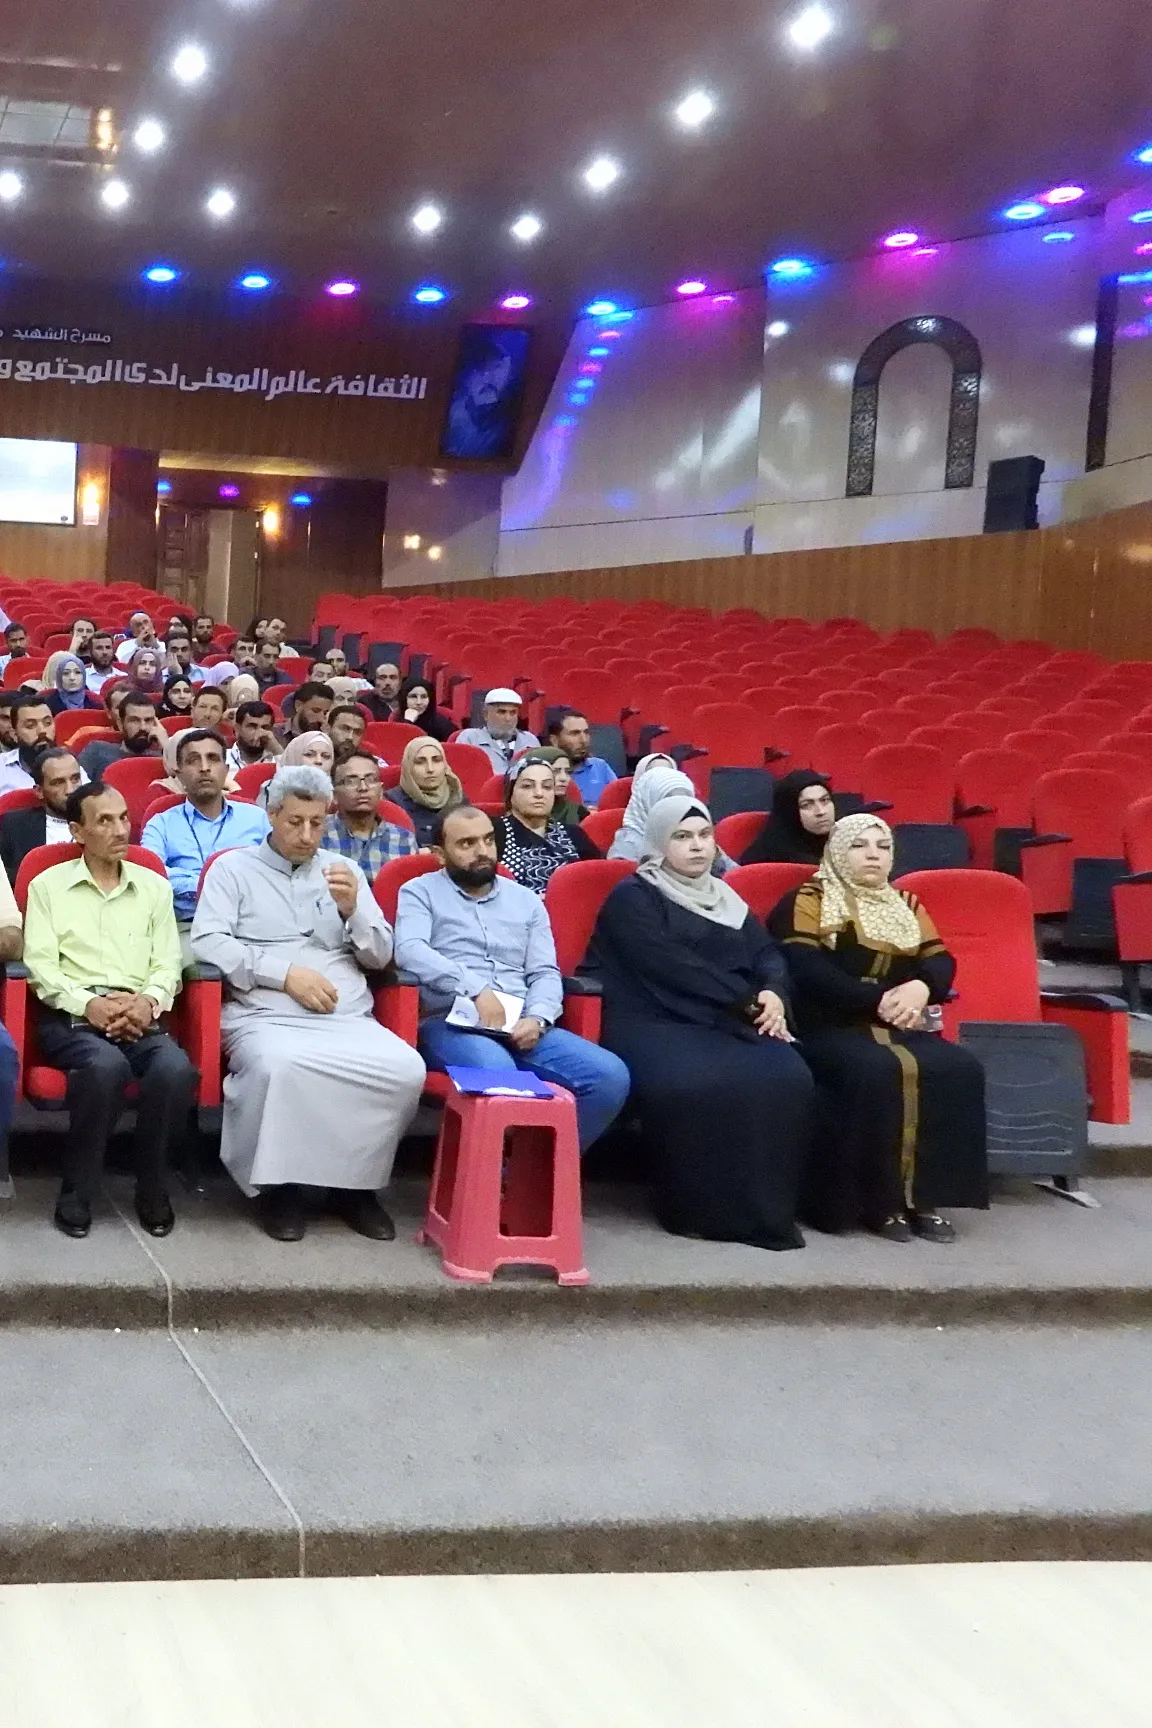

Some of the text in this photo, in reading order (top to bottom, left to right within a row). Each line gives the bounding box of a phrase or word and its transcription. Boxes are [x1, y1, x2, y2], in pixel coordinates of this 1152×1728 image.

[12, 327, 68, 341] الشهيد
[70, 328, 111, 343] مسرح
[14, 357, 124, 384] المجتمع
[179, 366, 269, 392] المعنى
[265, 369, 321, 401] عالم
[325, 374, 428, 399] الثقافة
